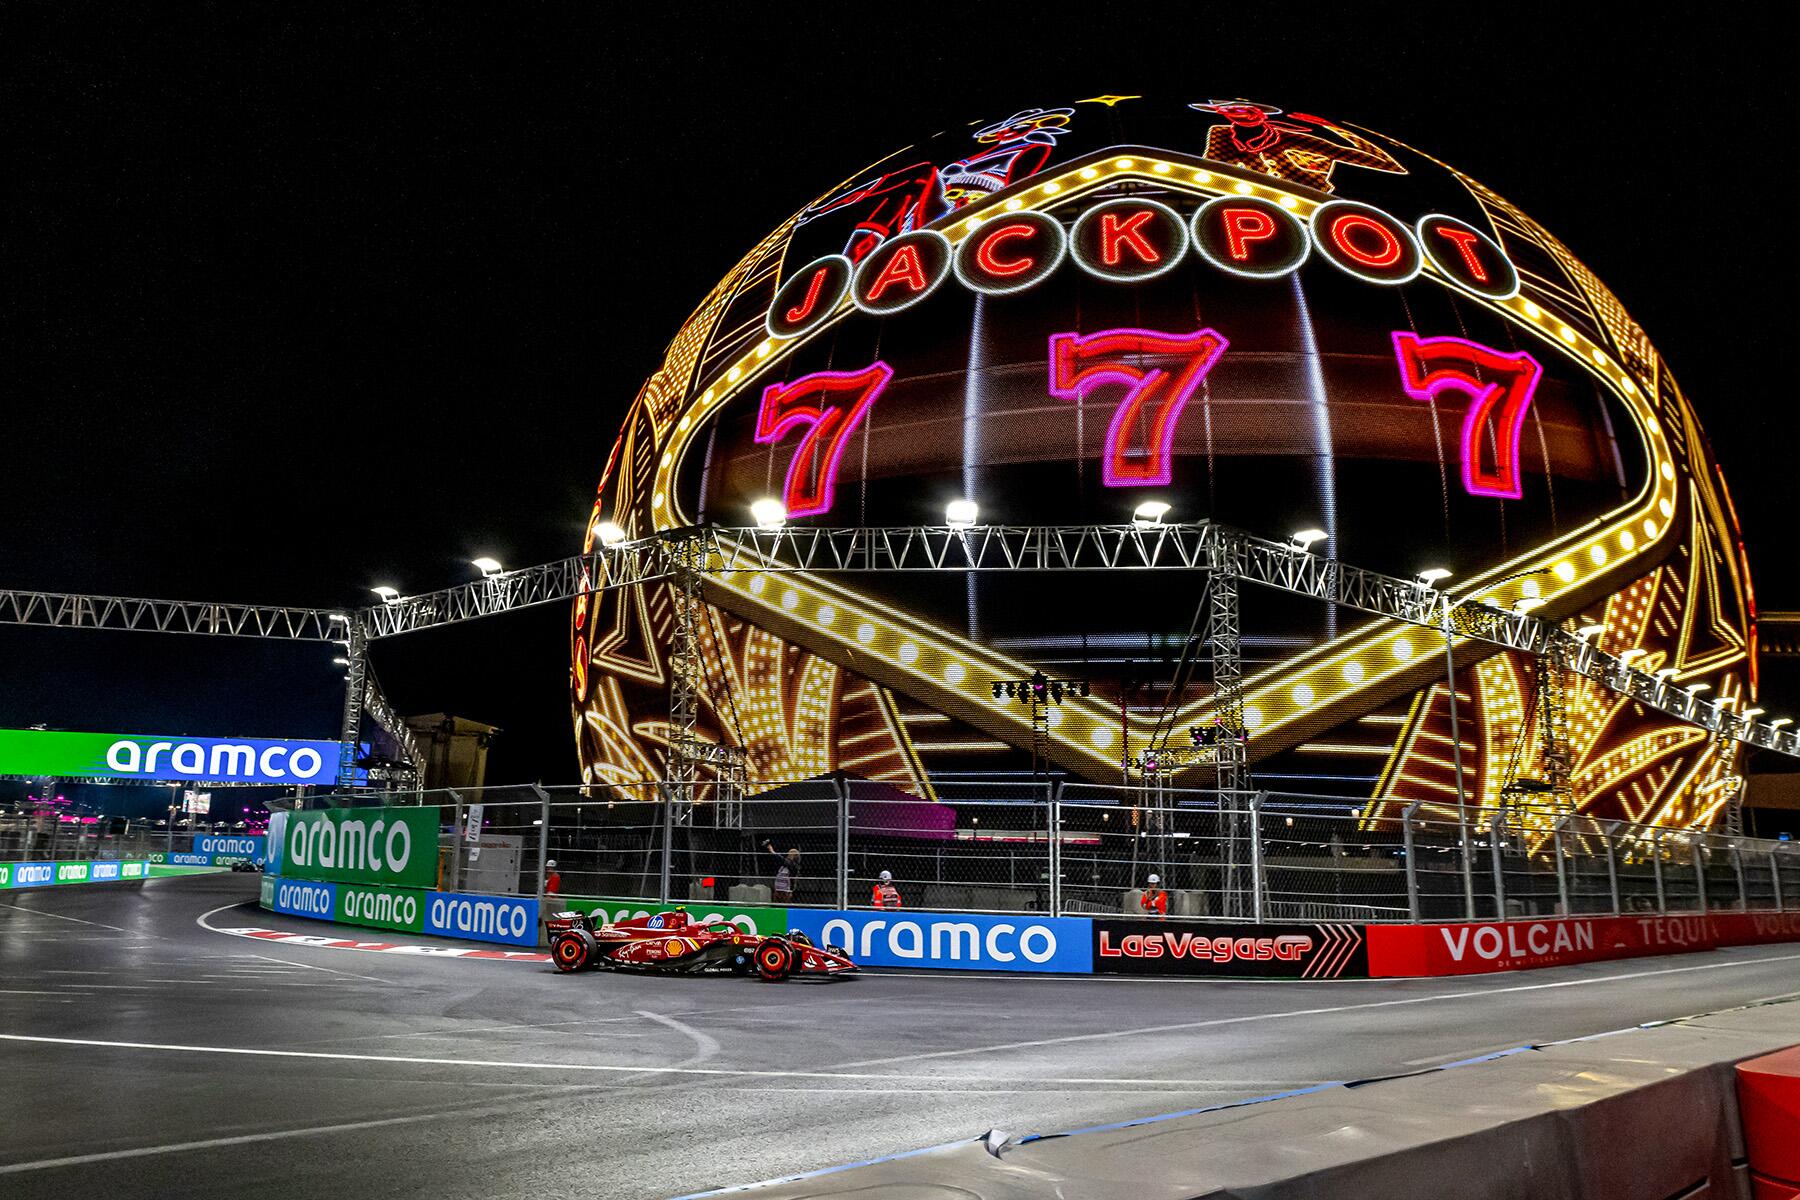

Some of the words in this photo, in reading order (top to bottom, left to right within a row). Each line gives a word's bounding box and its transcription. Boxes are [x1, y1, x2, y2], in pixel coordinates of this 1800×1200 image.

[785, 208, 1488, 323] JACKPOT
[754, 361, 894, 519] 7
[1049, 327, 1230, 487] 7
[1391, 330, 1543, 499] 7
[106, 740, 322, 779] aramco
[173, 854, 208, 865] aramco
[202, 838, 255, 854] aramco
[291, 819, 411, 873] aramco
[279, 884, 330, 914] aramco
[344, 890, 417, 925] aramco
[431, 898, 527, 938] aramco
[821, 917, 1058, 964] aramco
[649, 916, 663, 929] hp
[1440, 921, 1594, 961] VOLCAN
